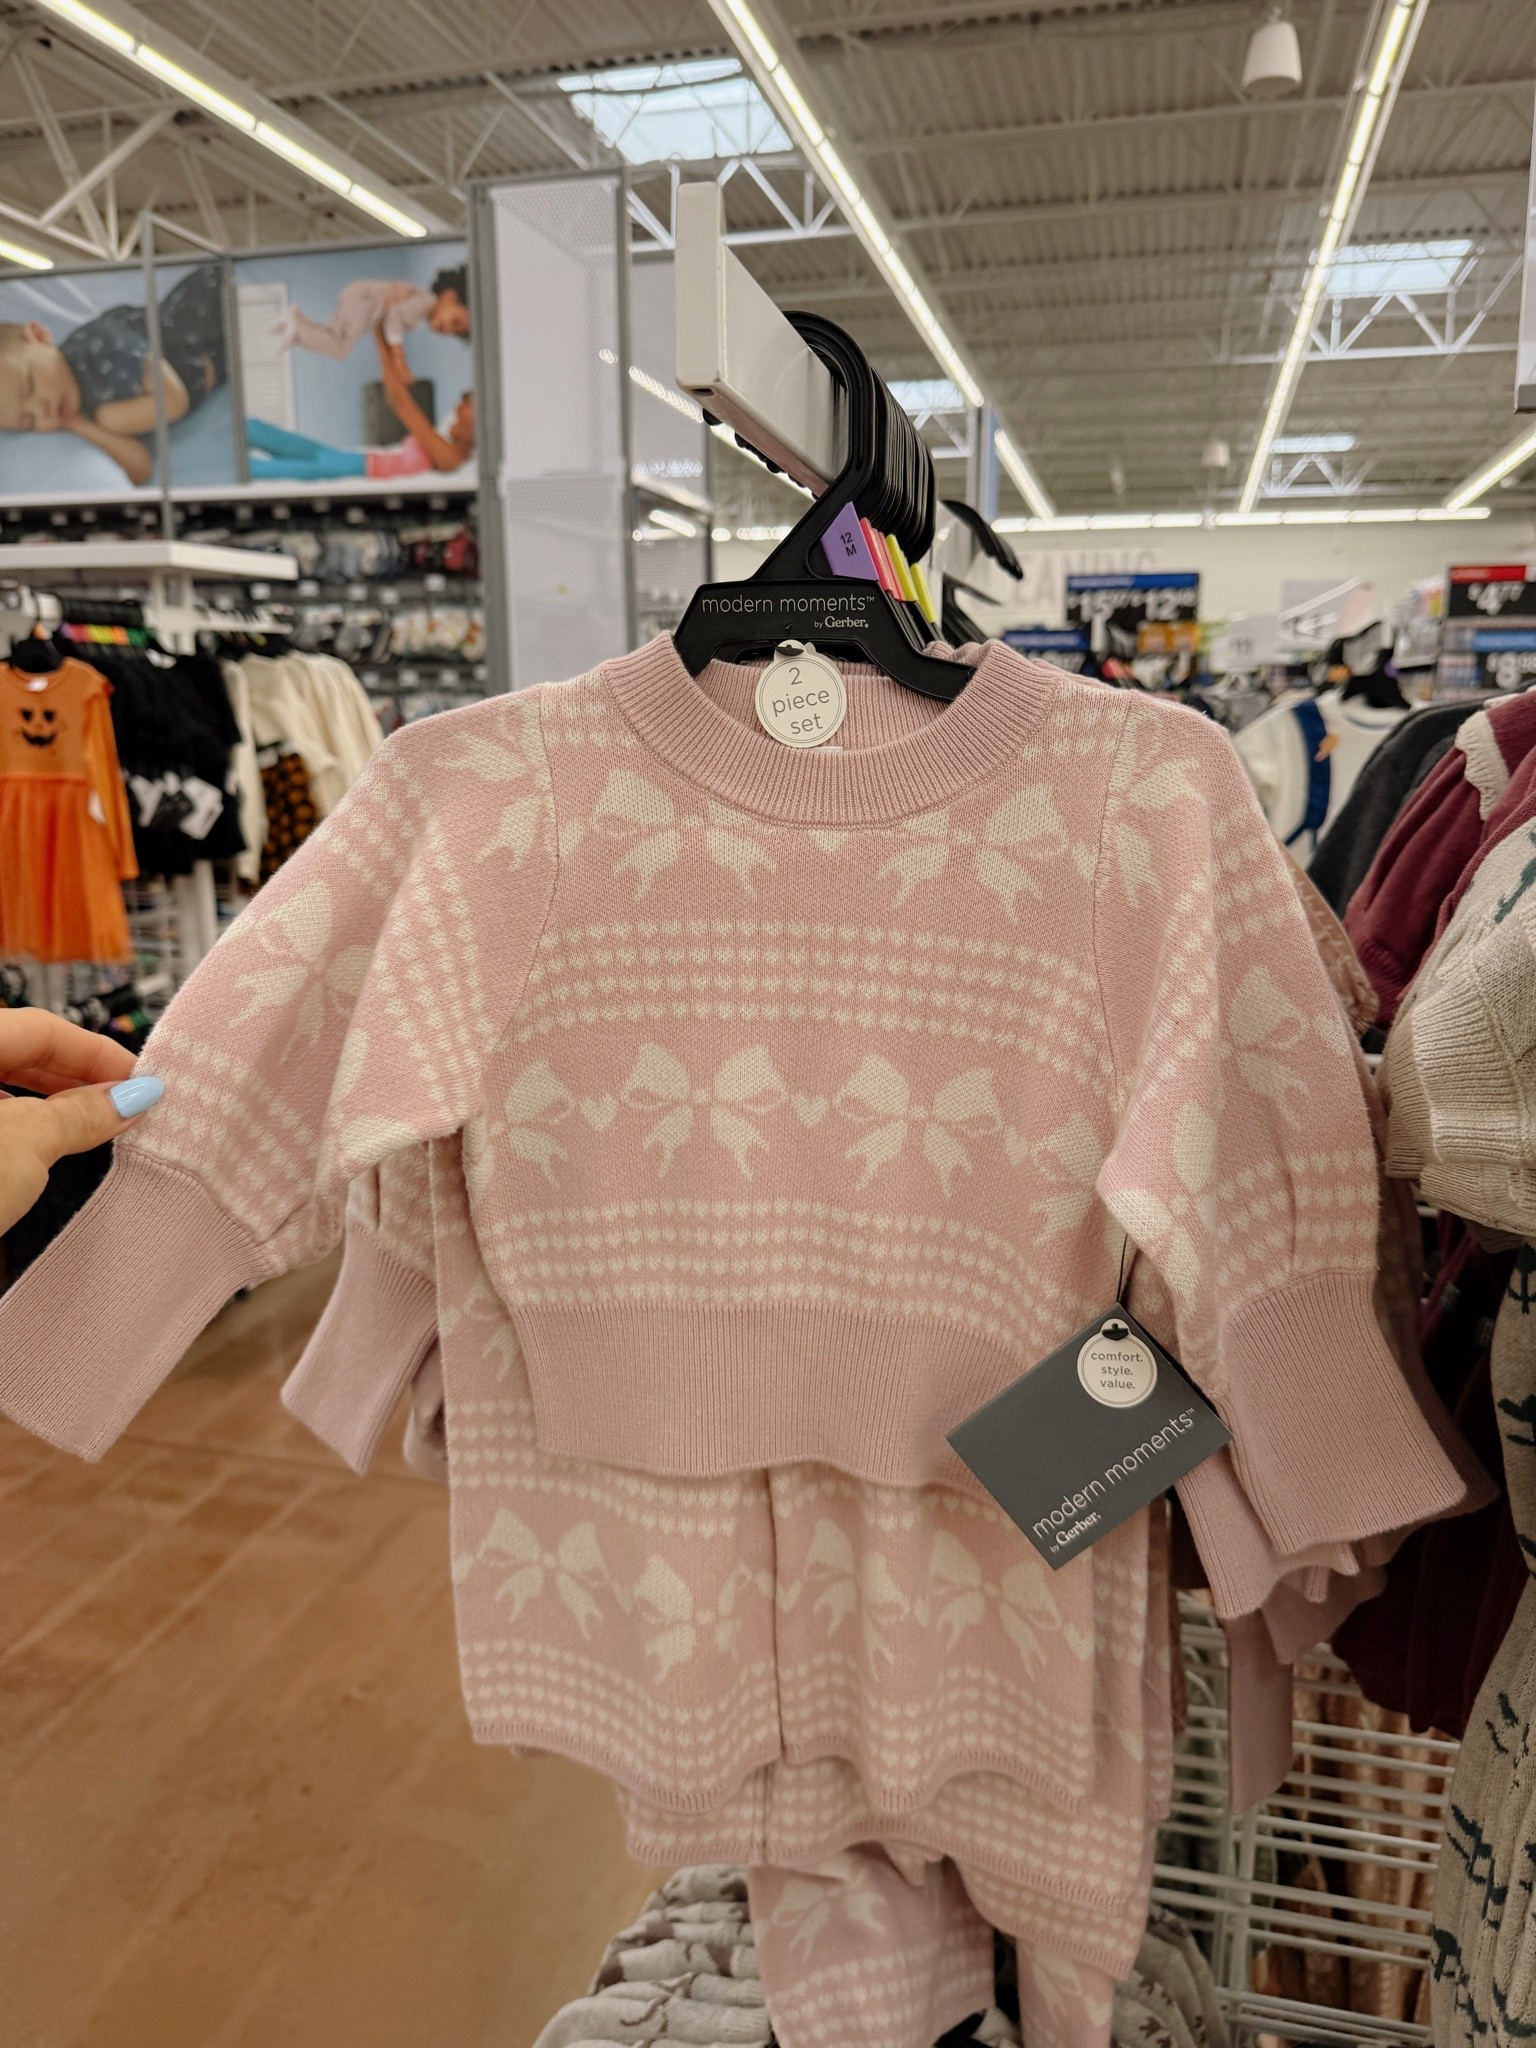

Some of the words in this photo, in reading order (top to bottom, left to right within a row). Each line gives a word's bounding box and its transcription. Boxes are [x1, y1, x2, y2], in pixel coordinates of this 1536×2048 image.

[840, 532, 853, 545] 12
[845, 544, 857, 557] M
[701, 594, 773, 613] modern
[814, 621, 823, 629] by
[788, 666, 803, 686] 2
[771, 690, 830, 718] piece
[789, 712, 824, 735] set
[1090, 1351, 1143, 1363] comfort.
[1101, 1365, 1133, 1376] style.
[1100, 1378, 1136, 1389] value.
[1032, 1478, 1107, 1540] modern
[1050, 1543, 1060, 1552] by
